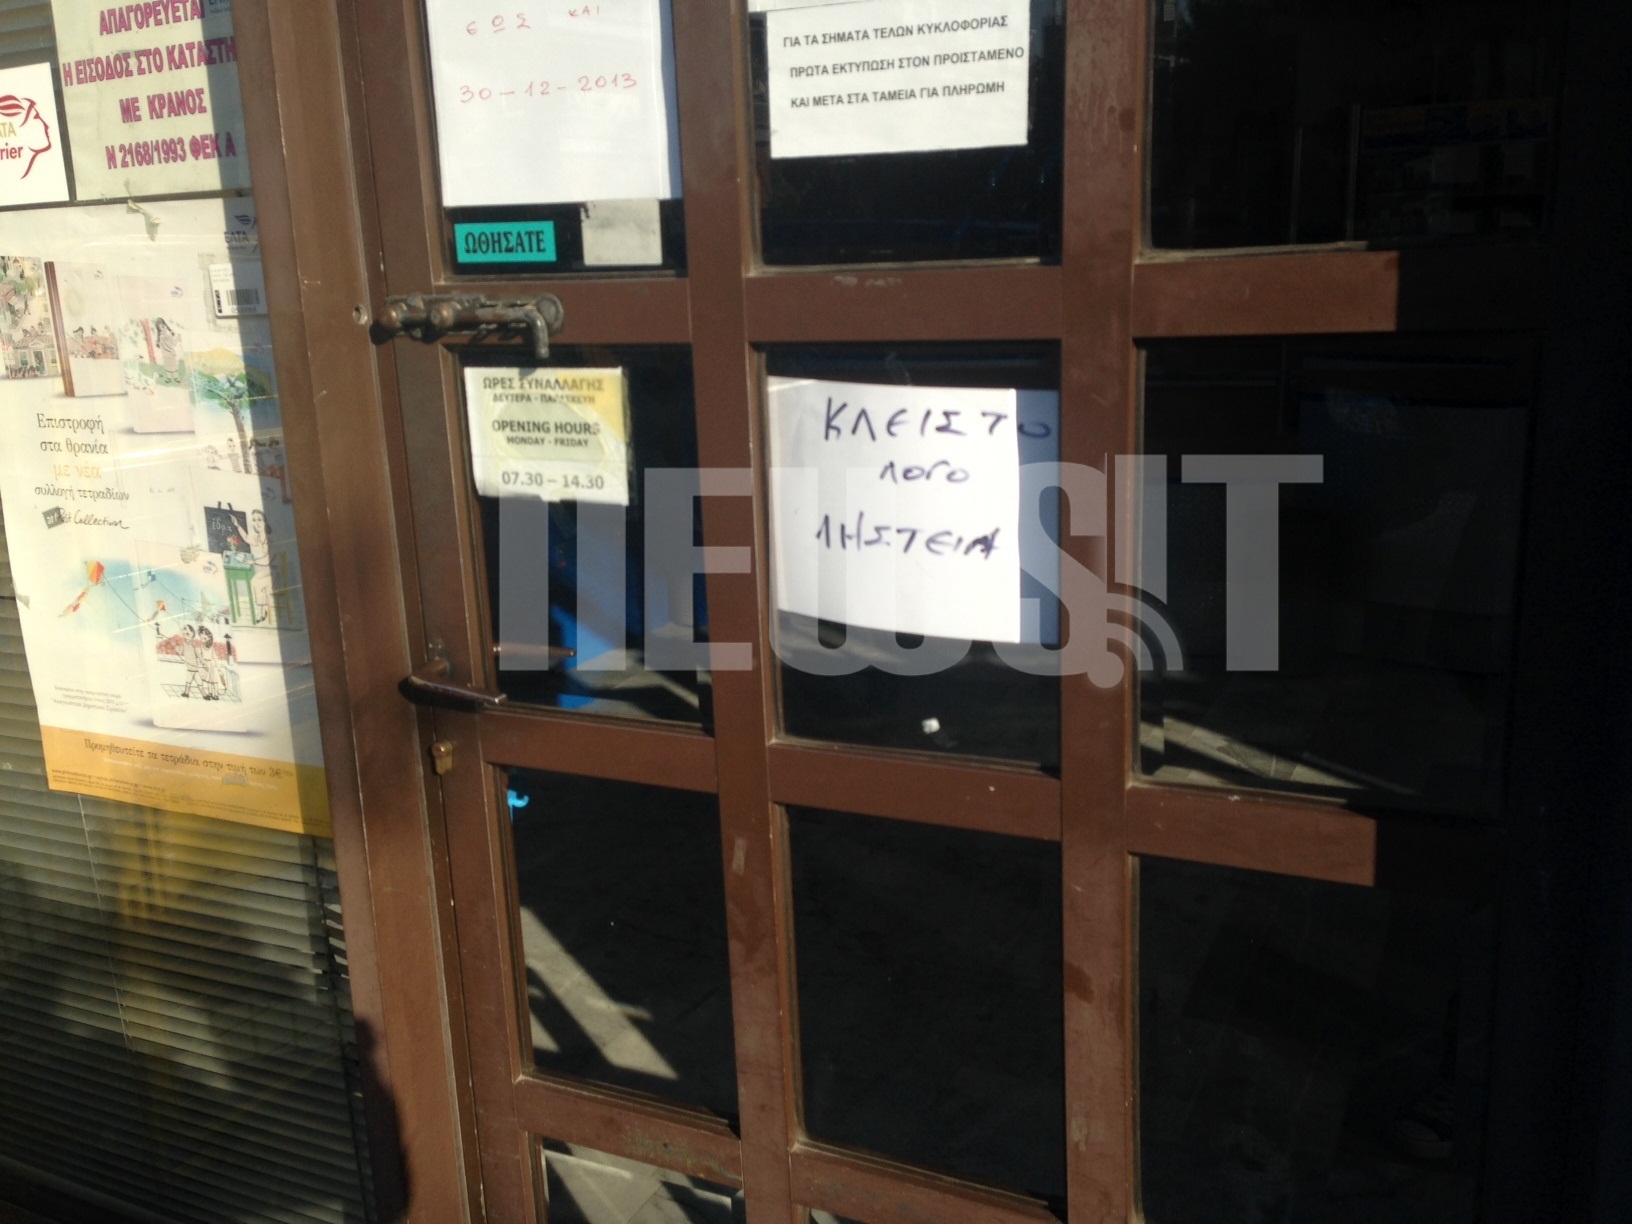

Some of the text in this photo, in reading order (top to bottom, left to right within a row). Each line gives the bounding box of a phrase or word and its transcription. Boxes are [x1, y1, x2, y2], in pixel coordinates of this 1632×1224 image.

[783, 15, 1009, 48] ΓΙΑ ΤΑ ΣΗΜΑΤΑ ΤΕΛΩΝ ΚΥΚΛΟΦΟΡΙΑΣ
[62, 63, 74, 87] Η
[76, 52, 134, 85] ΕΙΣΟΔΟΣ
[135, 47, 164, 76] ΣΤΟ
[790, 47, 1024, 78] ΠΡΩΤΑ ΕΚΤΥΠΩΣΗ ΣΤΟΝ ΠΡΟΙΣΤΑΜΕΝΟ
[119, 87, 207, 123] ΜΕ ΚΡΑΝΟΣ
[791, 81, 1005, 109] ΚΑΙ ΜΕΤΑ ΣΤΑ ΤΑΜΕΙΑ ΓΙΑ ΠΛΗΡΩΜΗ
[105, 145, 117, 170] Ν
[120, 136, 187, 168] 2168/1993
[189, 132, 222, 161] ΦΕΚ
[464, 230, 546, 255] ΩΘΗΣΑΤΕ
[483, 377, 515, 390] ΩΡΕΣ
[36, 413, 104, 434] Επιστροφή
[492, 420, 550, 433] OPENING
[40, 438, 108, 457] στα θρανία
[506, 436, 545, 446] MONDAY
[554, 437, 589, 447] FRIDAY
[501, 472, 543, 486] 07.30
[562, 475, 605, 489] 14.30
